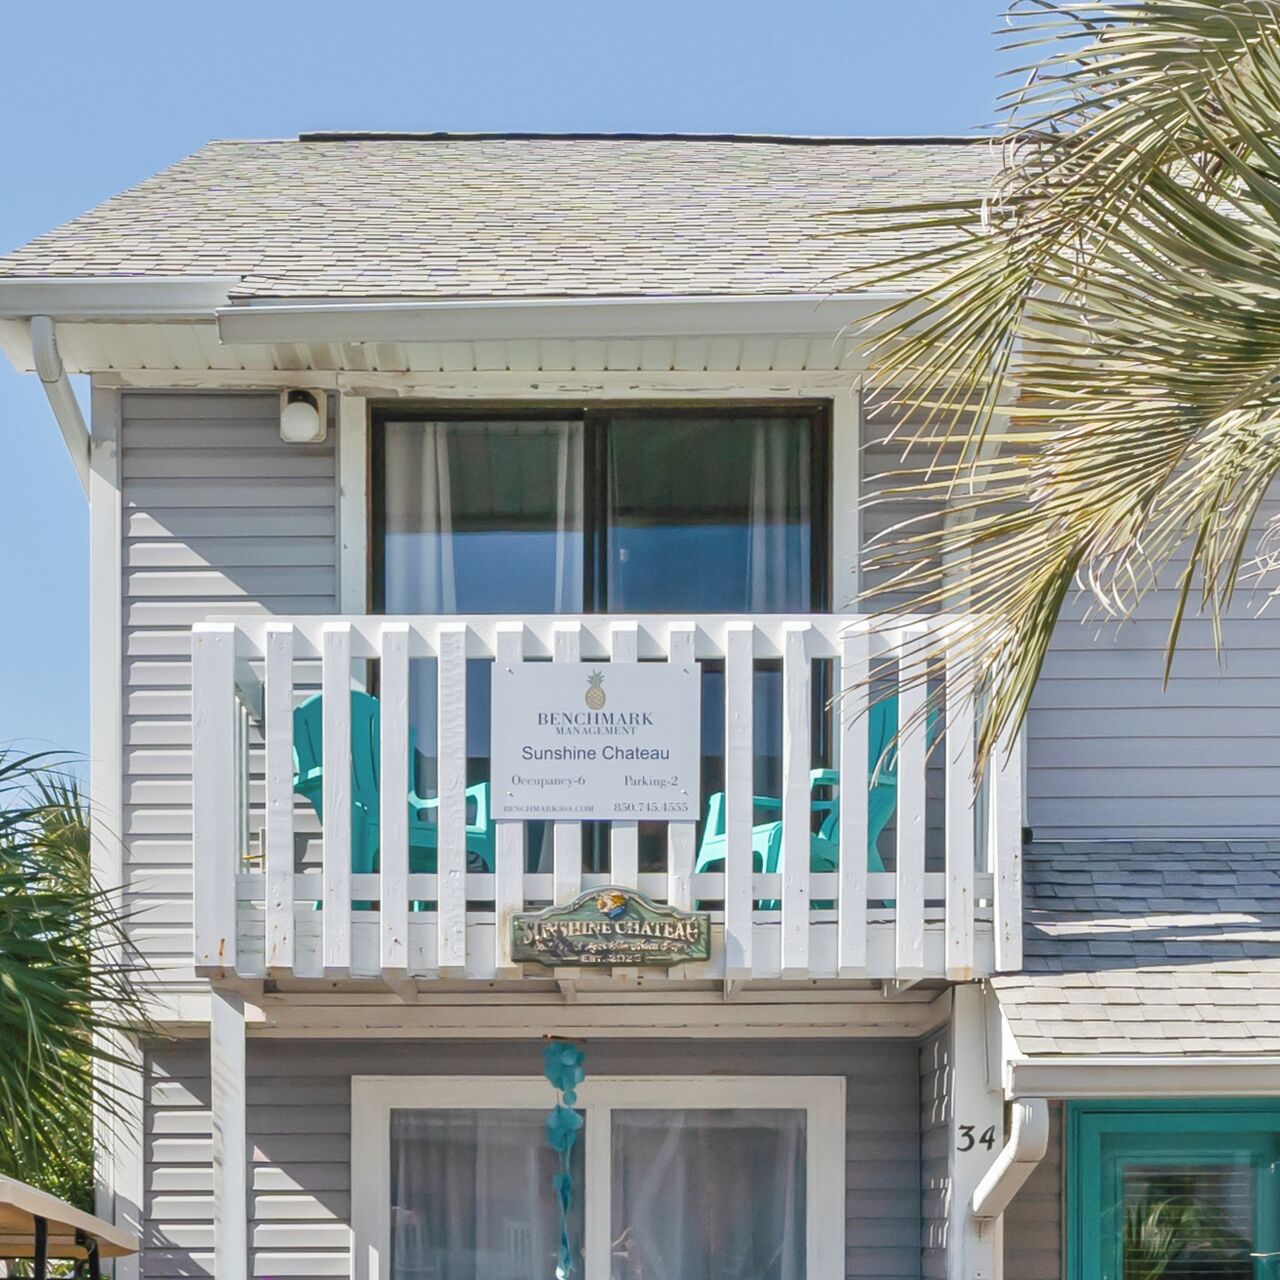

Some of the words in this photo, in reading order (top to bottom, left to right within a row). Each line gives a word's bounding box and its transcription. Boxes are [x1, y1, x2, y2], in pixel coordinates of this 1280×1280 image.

[537, 712, 654, 726] BENCHMARK
[555, 727, 637, 735] MANAGEMENT
[521, 745, 597, 760] Sunshine
[602, 745, 670, 760] Chateau
[511, 774, 586, 788] Occupancy-6
[624, 774, 679, 788] Parking-2
[613, 802, 688, 812] 850.745.4555
[524, 920, 611, 944] SUNSHINE
[615, 917, 698, 942] CHATEAU
[956, 1124, 995, 1152] 34
